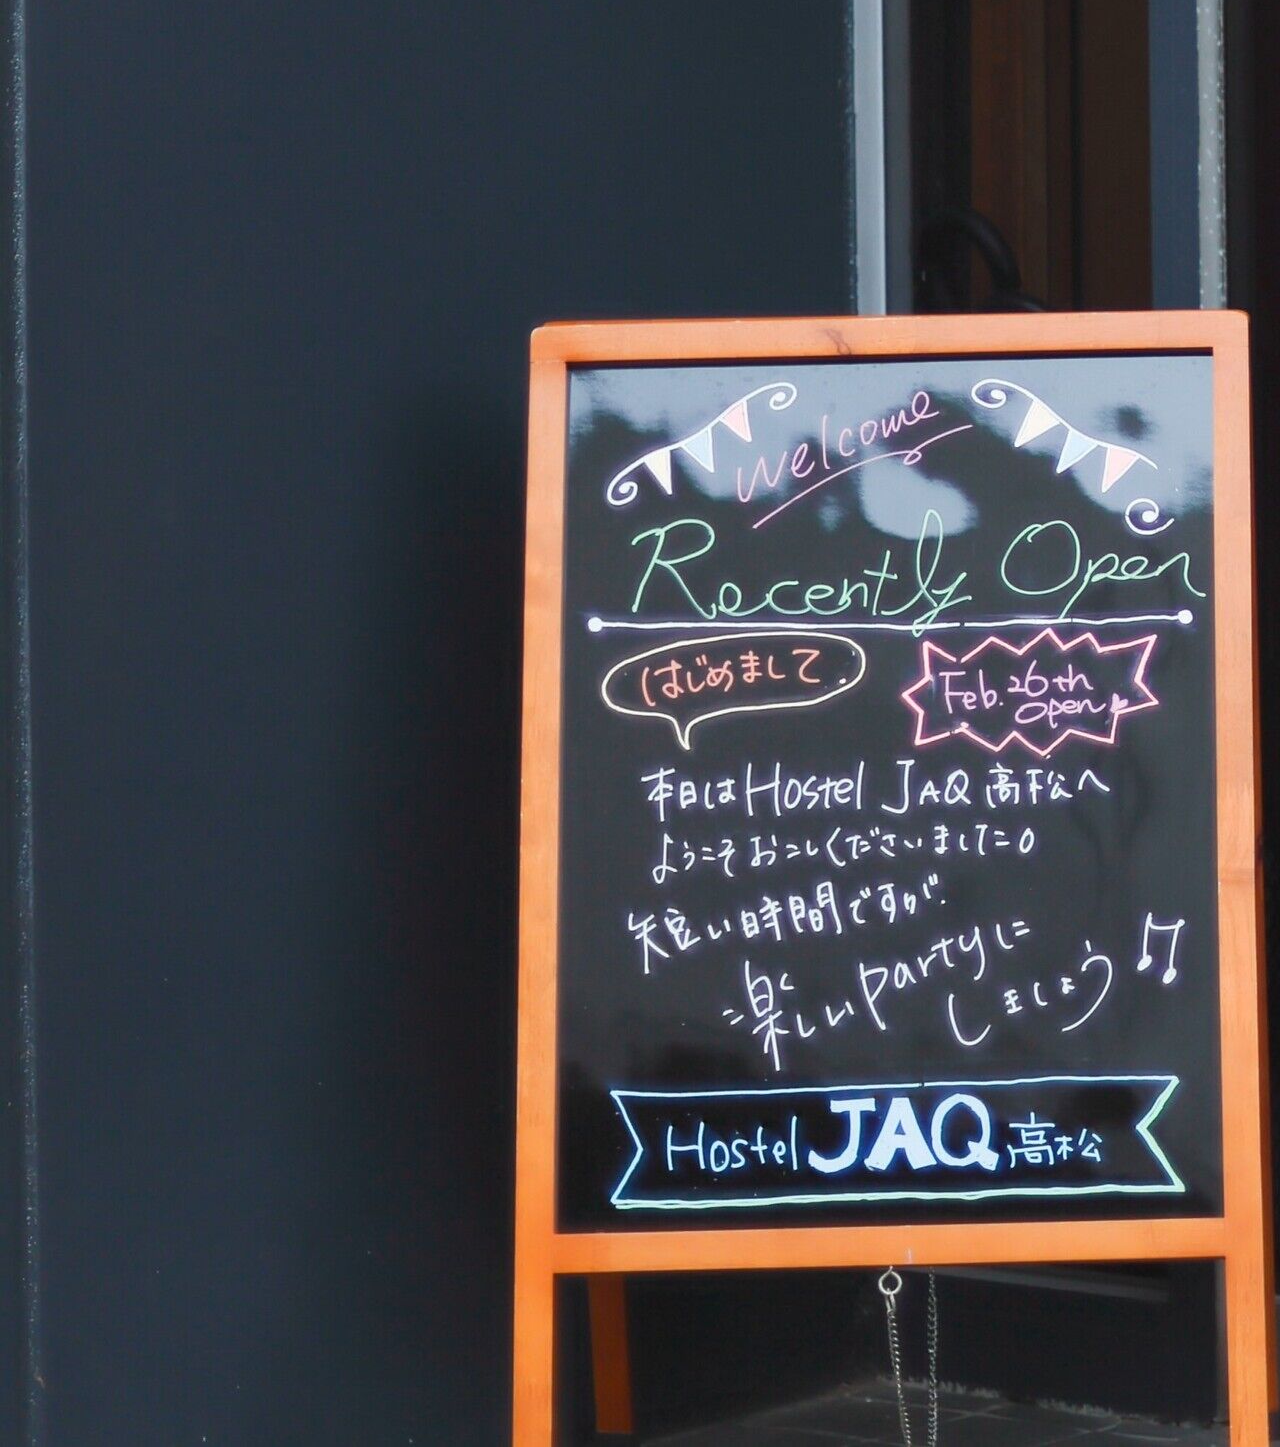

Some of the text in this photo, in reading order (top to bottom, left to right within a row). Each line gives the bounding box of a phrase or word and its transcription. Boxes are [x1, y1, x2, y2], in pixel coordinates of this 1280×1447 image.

[632, 509, 1206, 637] Recently Open
[938, 669, 1006, 715] Feb.
[666, 1093, 1103, 1173] Hostel JAQ 高松
